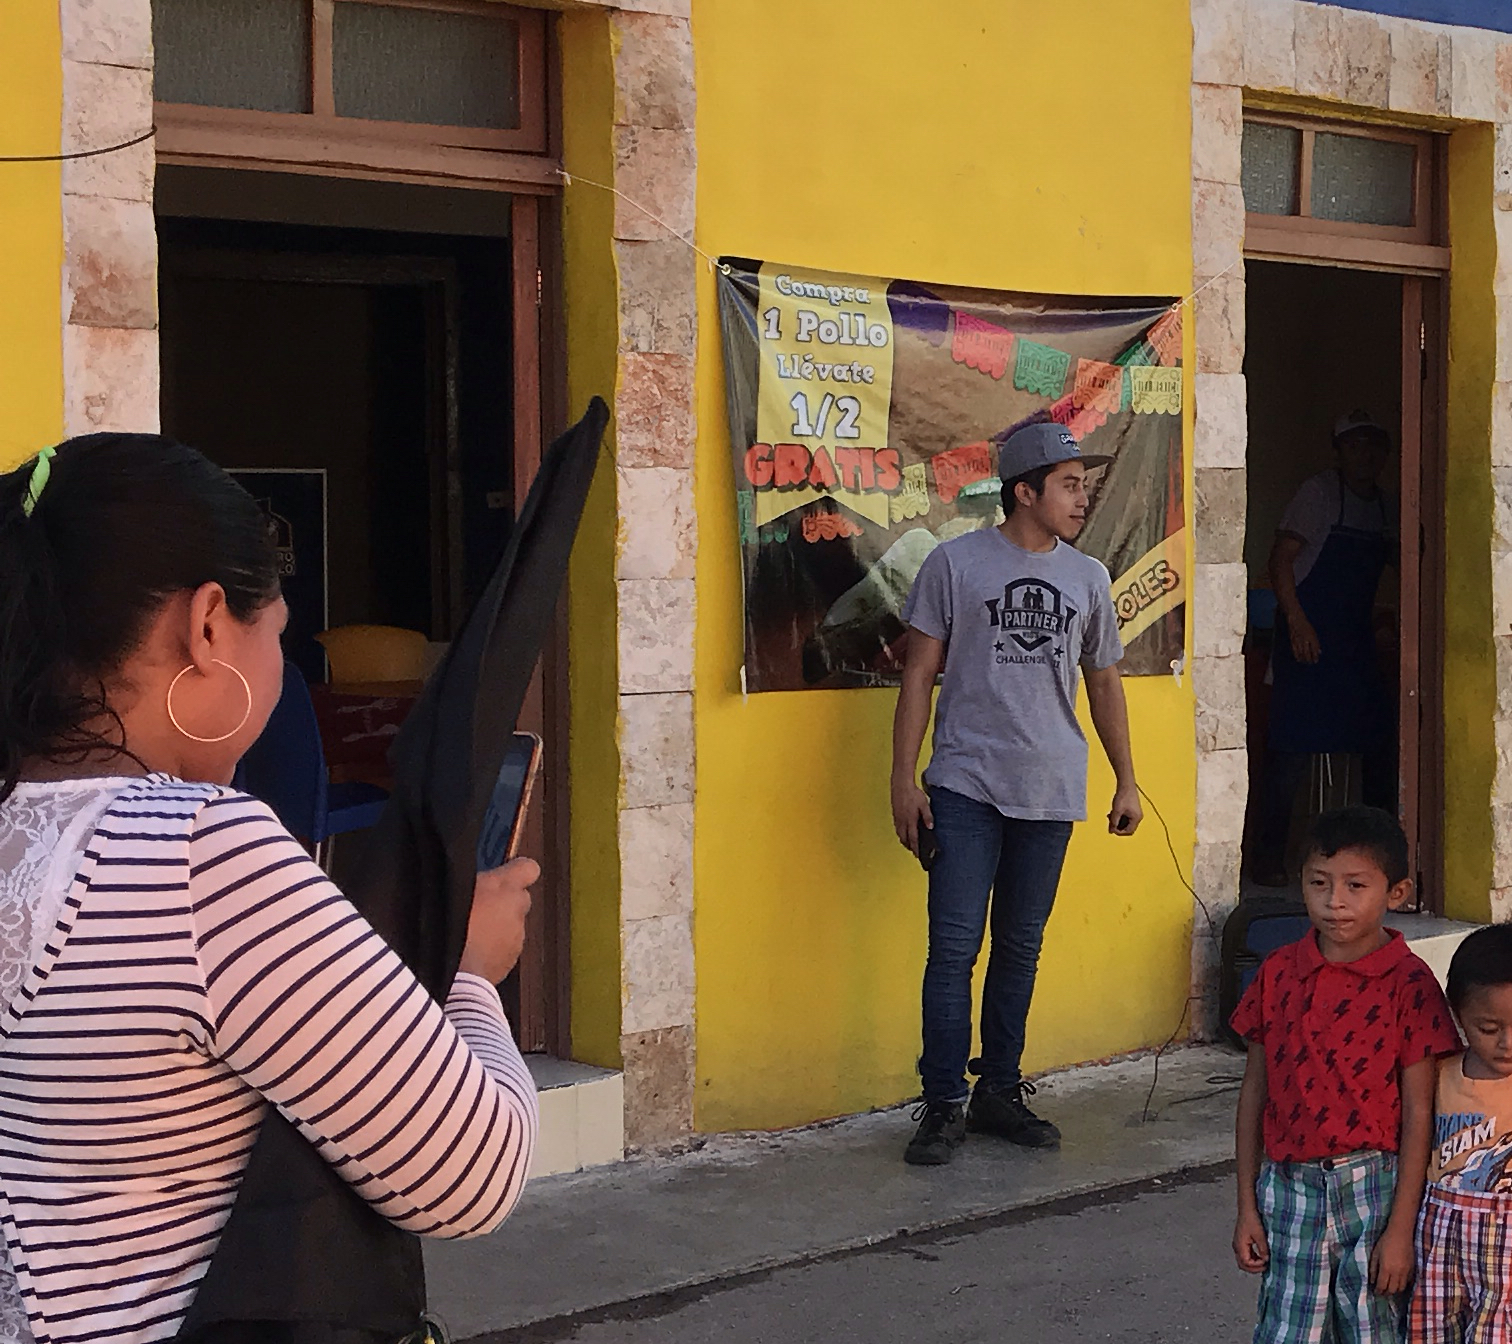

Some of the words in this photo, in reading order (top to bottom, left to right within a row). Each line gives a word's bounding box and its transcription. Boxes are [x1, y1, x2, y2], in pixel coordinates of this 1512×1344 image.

[775, 274, 871, 306] Compra
[763, 307, 782, 340] 1
[796, 310, 889, 348] Pollo
[777, 353, 876, 384] Llévate
[790, 391, 861, 439] 1/2
[743, 443, 903, 494] GRATIS
[1113, 560, 1179, 630] OLES
[1004, 611, 1058, 631] PARTNER
[1439, 1116, 1497, 1170] SLAM
